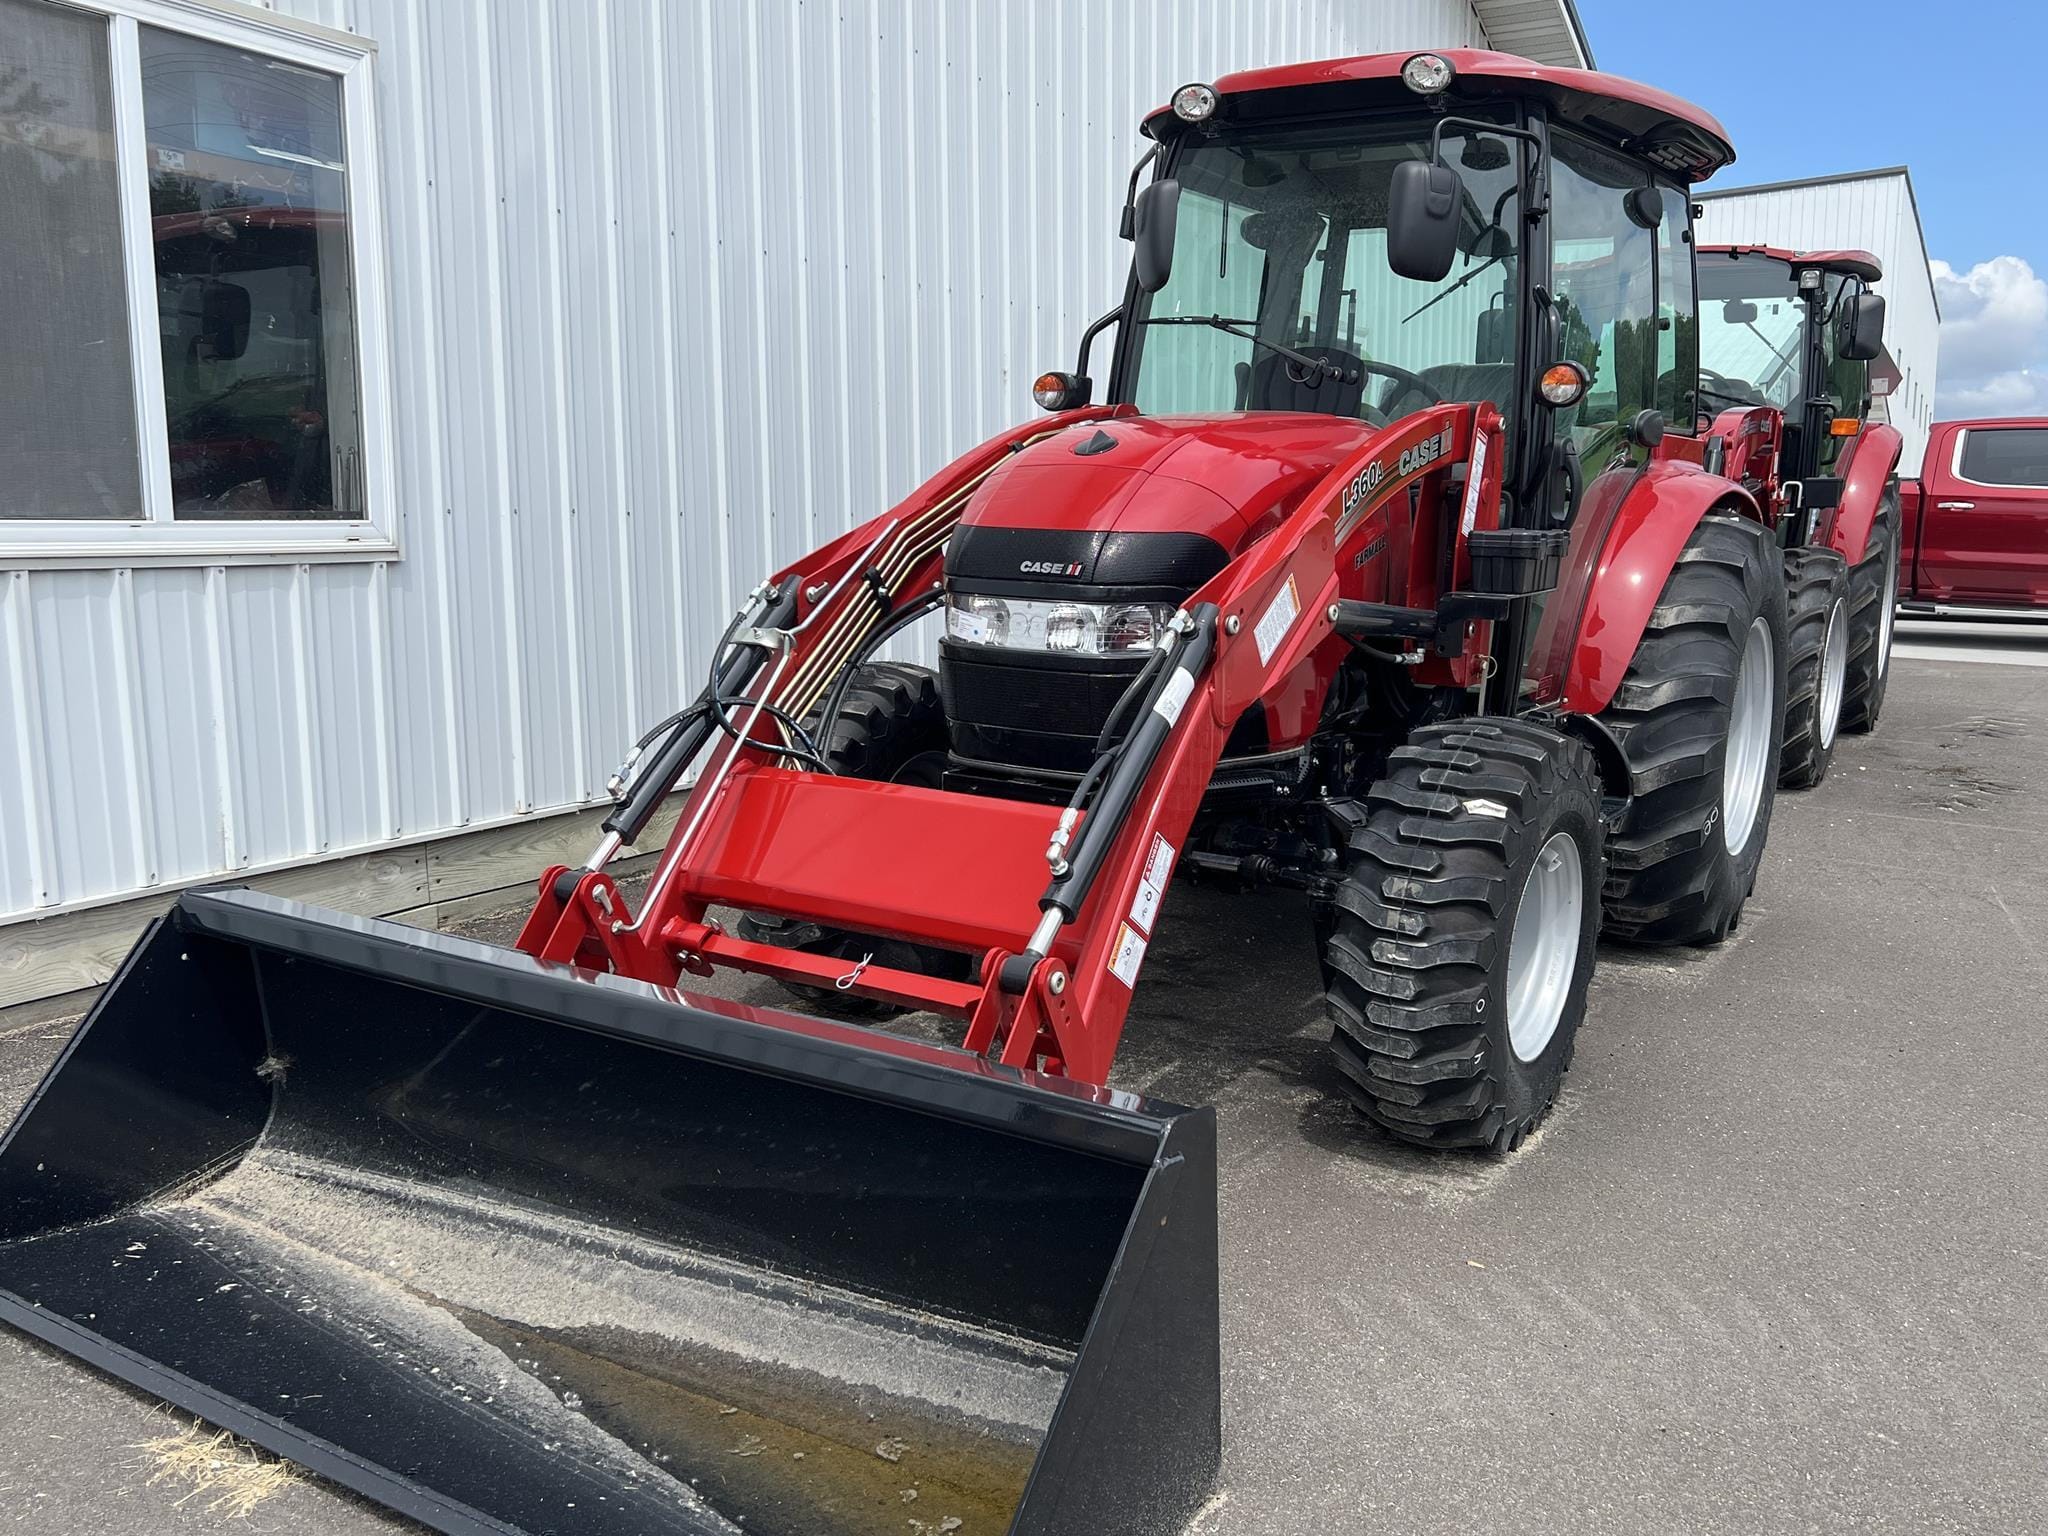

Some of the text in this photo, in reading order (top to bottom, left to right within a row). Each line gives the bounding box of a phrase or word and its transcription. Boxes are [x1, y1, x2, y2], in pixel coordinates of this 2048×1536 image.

[1399, 433, 1441, 477] CASE
[1342, 460, 1384, 517] L360A
[1020, 560, 1064, 574] CASE
[1354, 535, 1386, 571] FARMALL
[1147, 838, 1160, 870] DANGER
